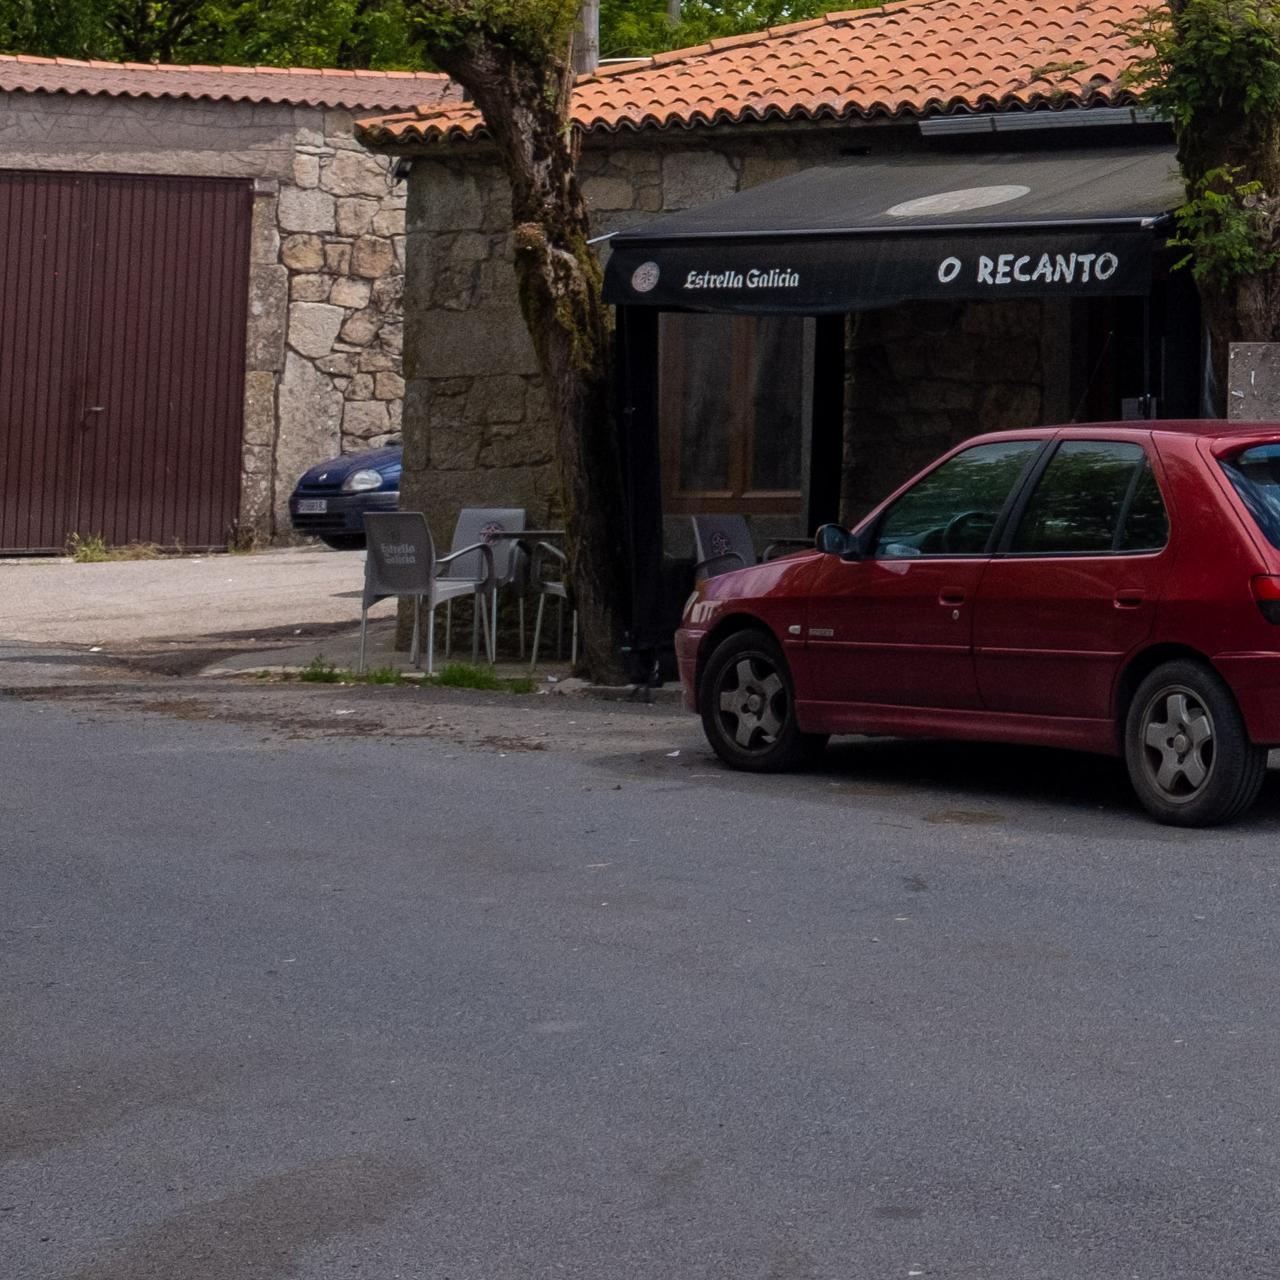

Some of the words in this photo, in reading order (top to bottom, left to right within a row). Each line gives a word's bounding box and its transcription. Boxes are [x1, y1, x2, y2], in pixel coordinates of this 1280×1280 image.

[683, 270, 744, 289] Estrella
[746, 268, 800, 289] Galicia
[937, 256, 961, 284] O
[977, 251, 1118, 285] RECANTO
